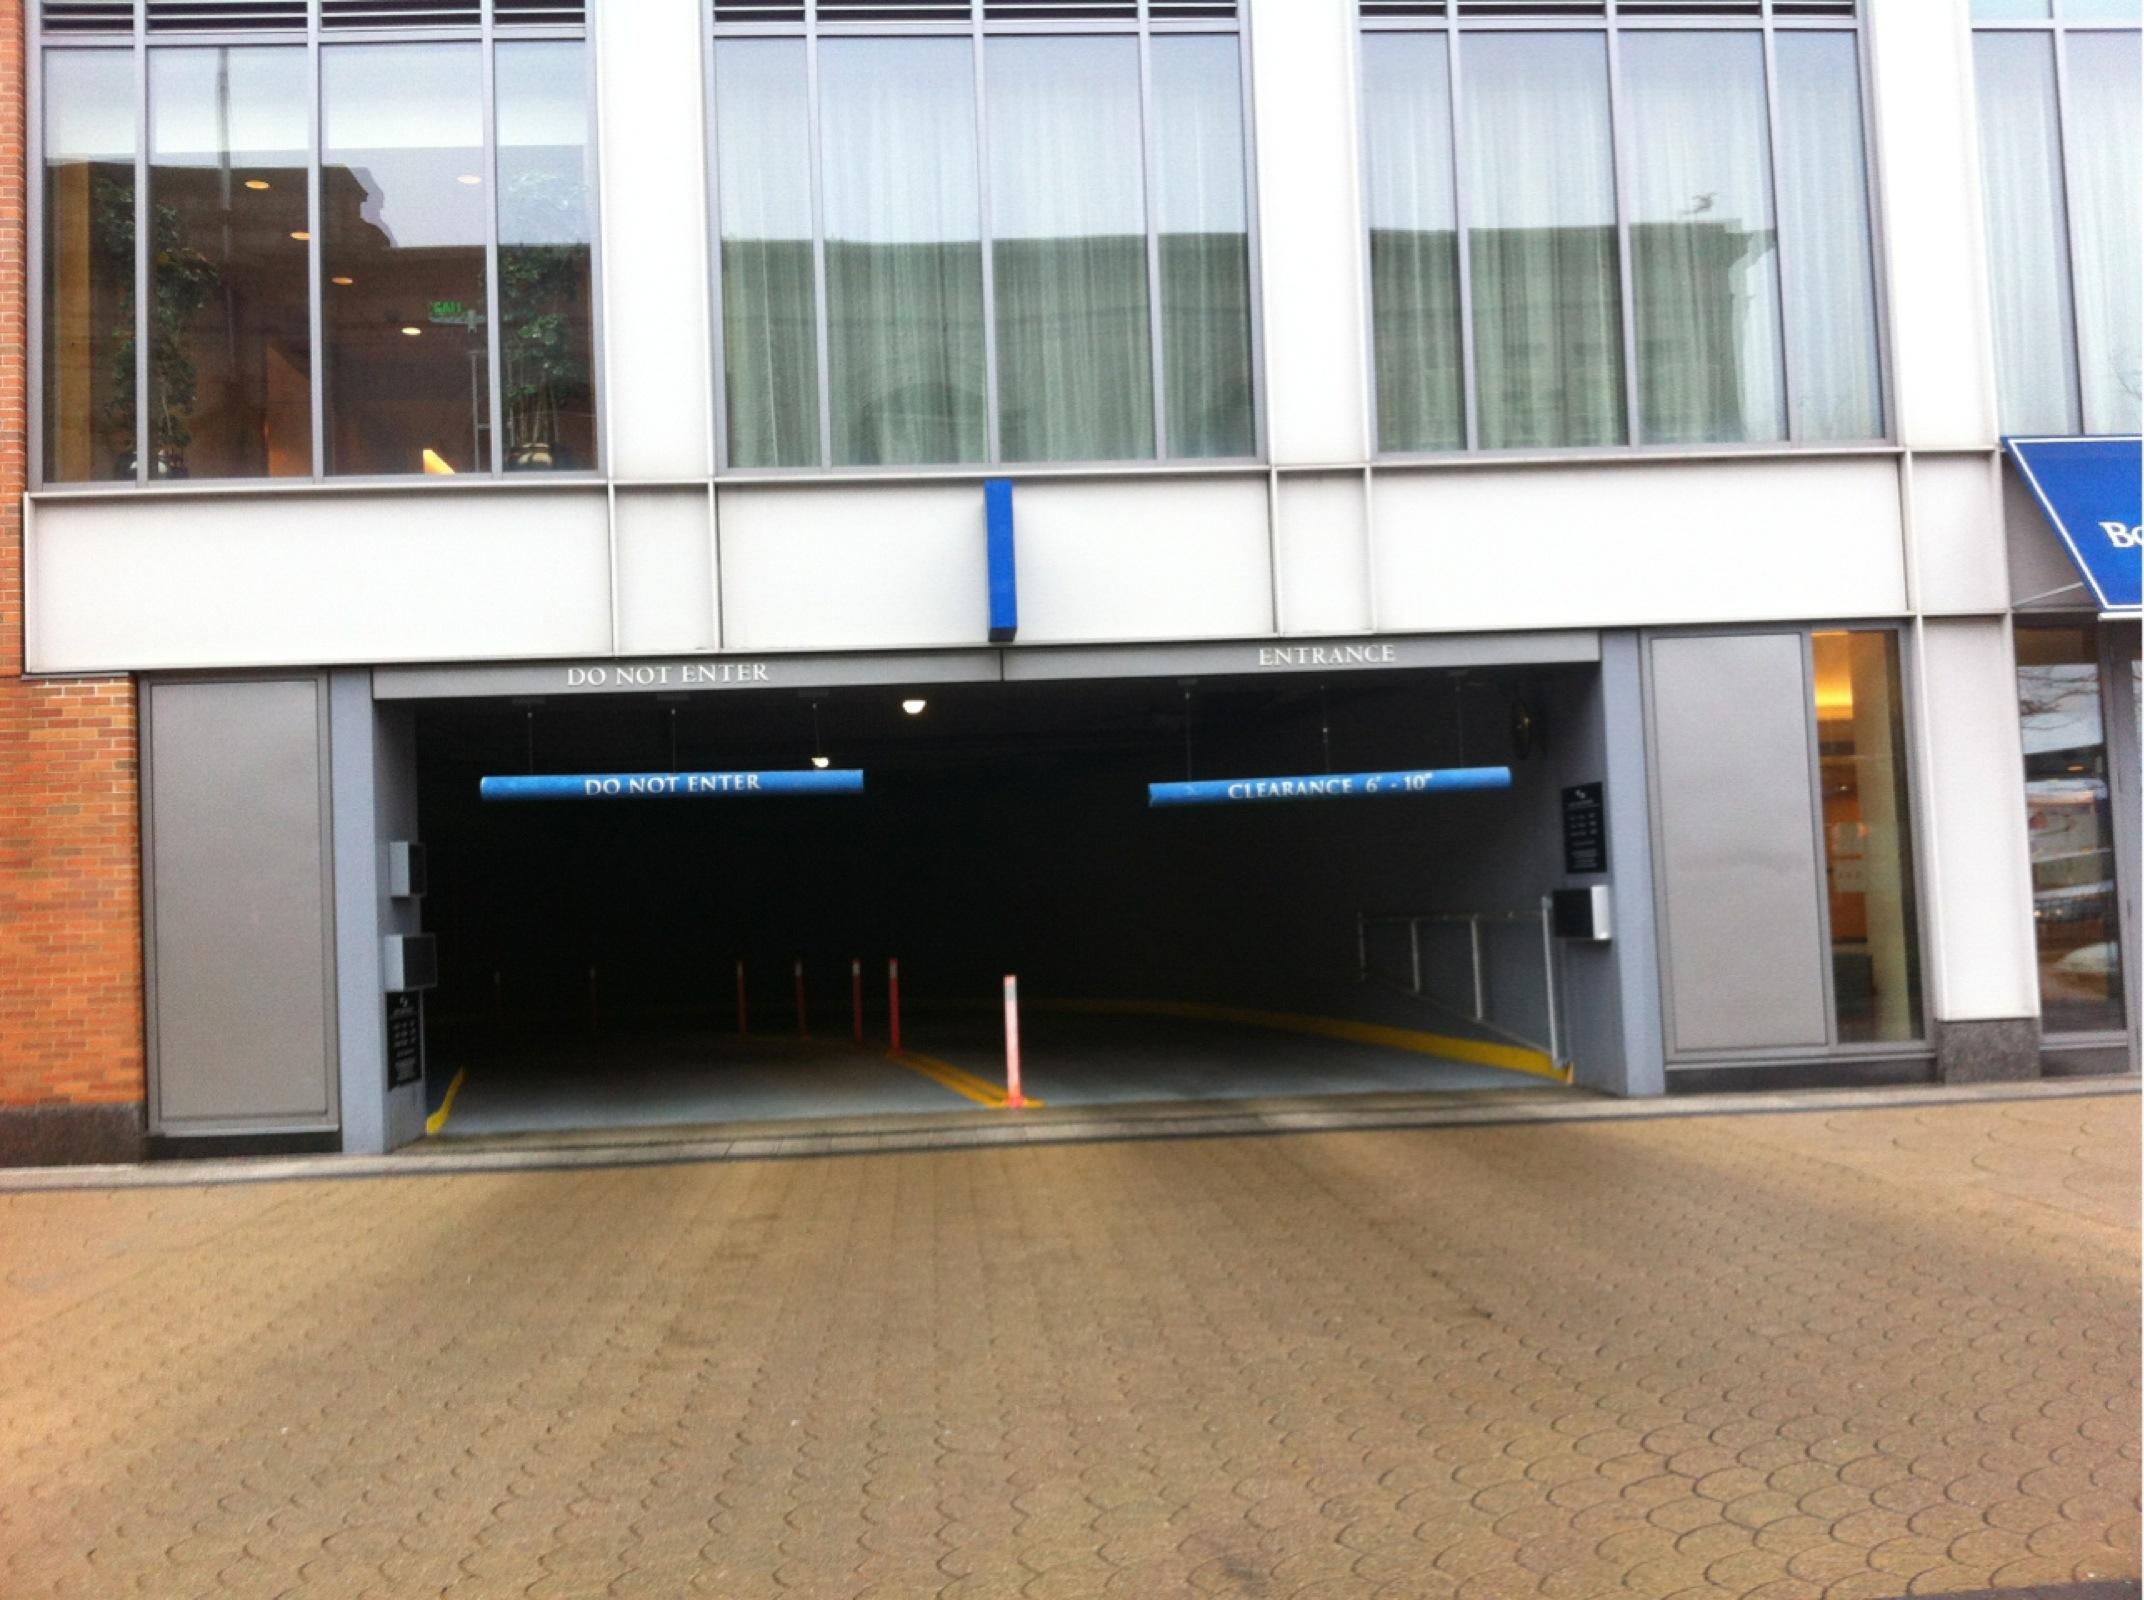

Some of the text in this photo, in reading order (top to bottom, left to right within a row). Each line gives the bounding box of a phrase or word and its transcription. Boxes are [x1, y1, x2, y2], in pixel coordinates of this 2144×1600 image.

[1258, 645, 1397, 666] ENTRANCE
[566, 663, 770, 686] DO NOT ENTER
[584, 774, 761, 795] DO NOT ENTER
[1228, 778, 1353, 799] CLEARANCE
